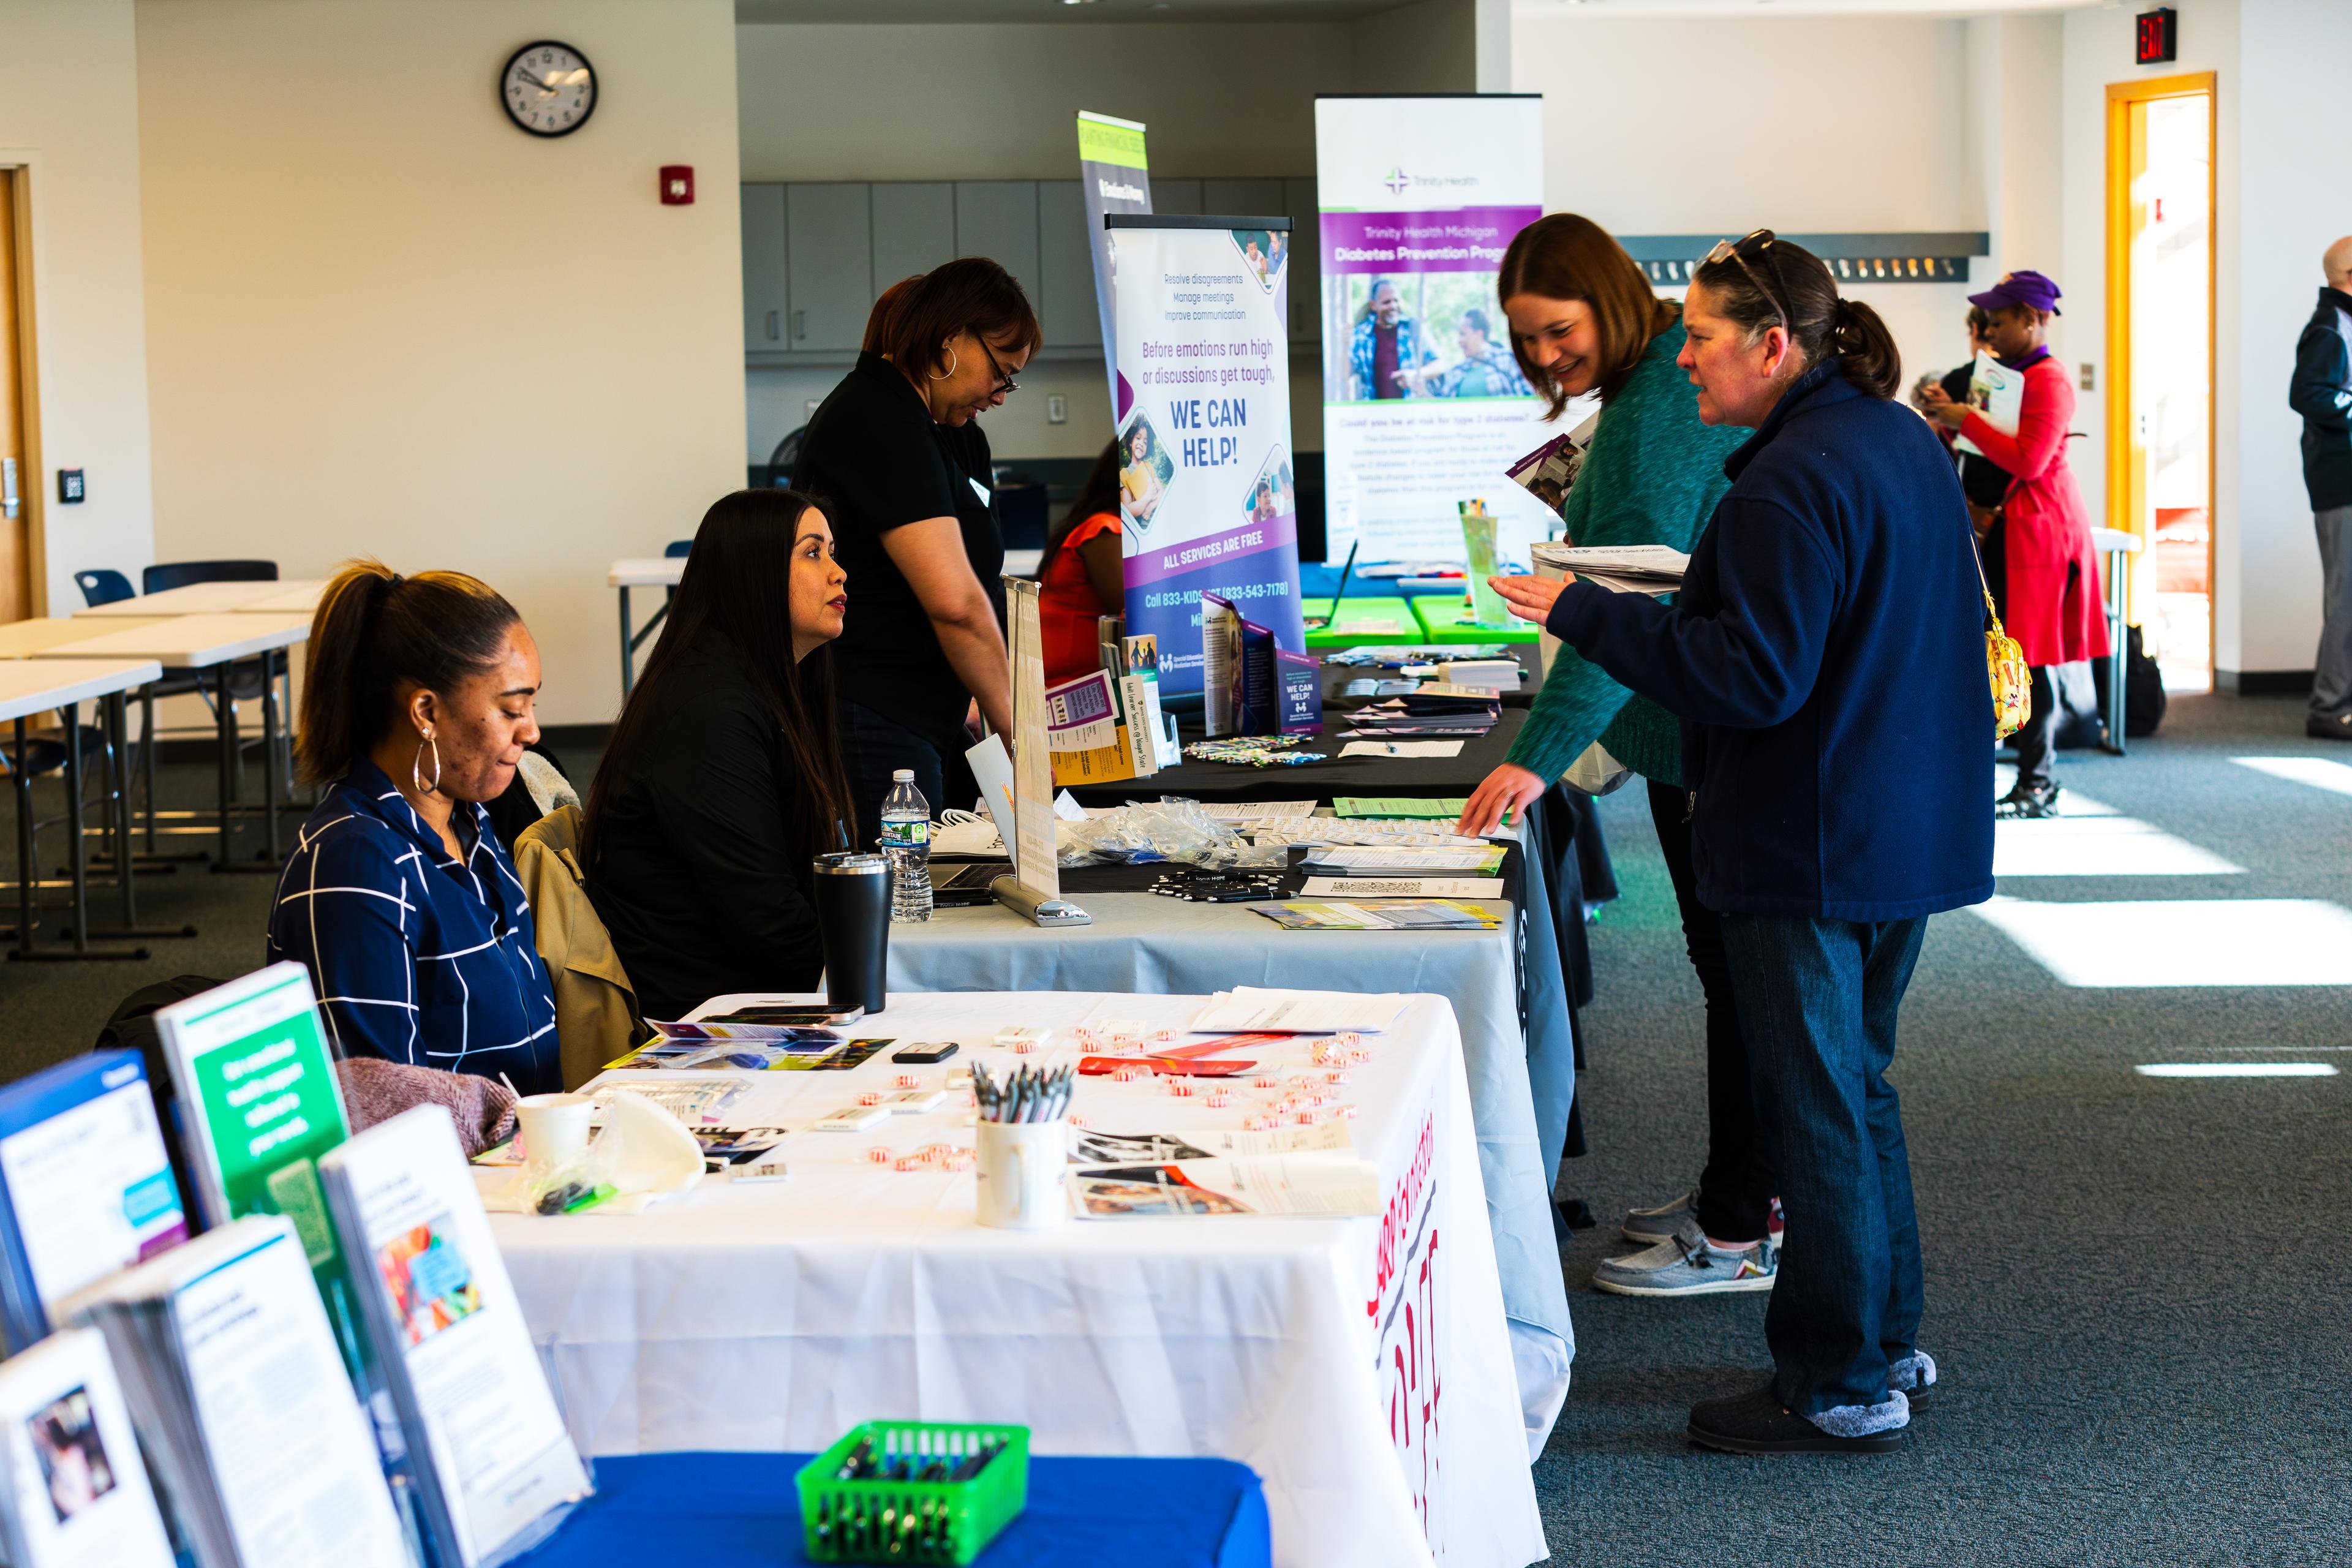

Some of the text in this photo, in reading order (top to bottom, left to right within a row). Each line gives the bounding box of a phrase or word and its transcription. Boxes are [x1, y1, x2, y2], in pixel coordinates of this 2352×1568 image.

[1363, 226, 1498, 241] Trinity Health Michigan
[1335, 245, 1507, 263] Diabetes Prevention Prog
[1164, 273, 1243, 285] Resolve disagreements
[1174, 292, 1234, 304] Manage meetings
[1165, 309, 1246, 322] Improve communication
[1143, 339, 1273, 360] Before emotions run high
[1143, 364, 1275, 386] or discussions get tough,
[1170, 398, 1246, 429] WE CAN
[1183, 436, 1238, 467] HELP!
[1527, 448, 1547, 465] COMMUNICATION
[1164, 530, 1264, 570] ALL SERVICES ARE FREE
[1145, 593, 1161, 608] Call
[1223, 581, 1289, 601] (833-543-7178)
[1291, 692, 1310, 701] HELP!
[1135, 736, 1144, 753] Wayne
